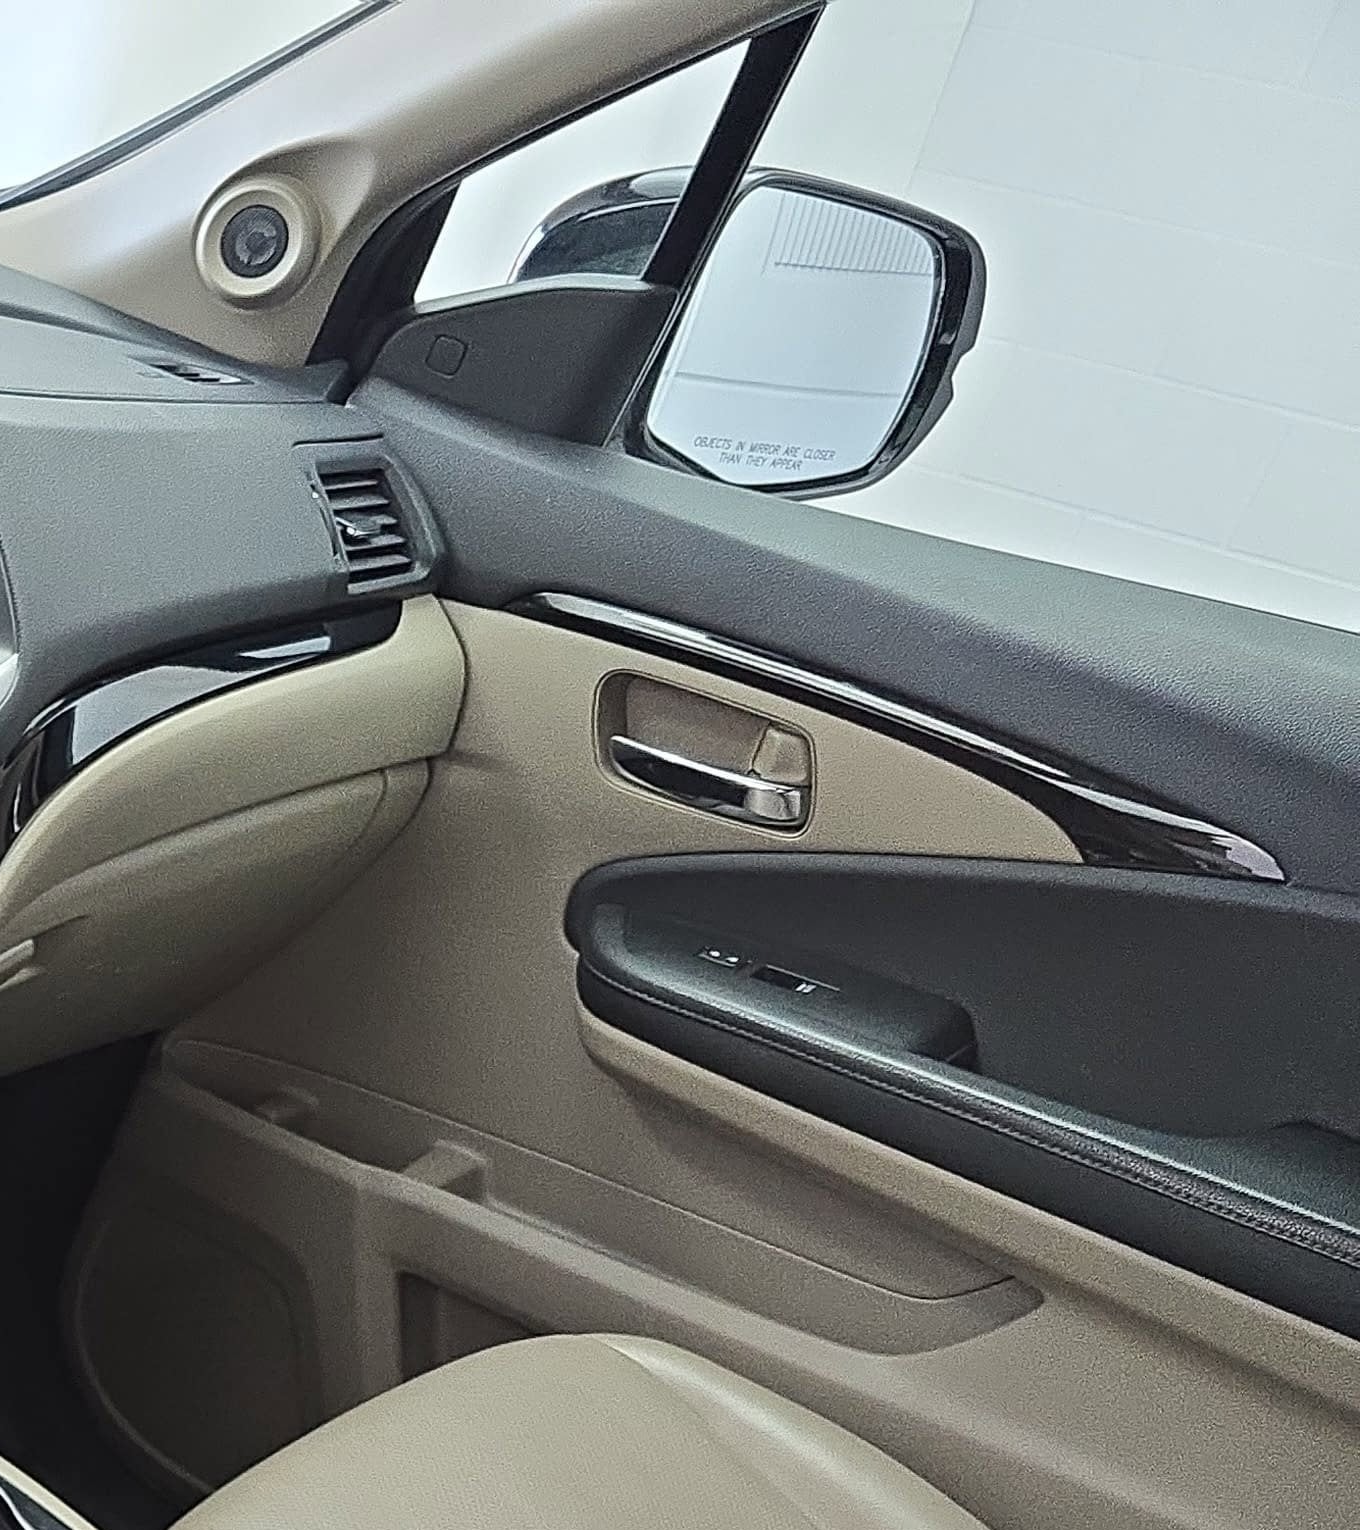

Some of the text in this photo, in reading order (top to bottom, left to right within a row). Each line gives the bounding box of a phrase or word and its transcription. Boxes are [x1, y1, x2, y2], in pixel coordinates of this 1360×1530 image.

[693, 436, 836, 461] OBJECTS IN MIRROR ARE CLOSER
[719, 452, 803, 471] THAN THEY APPEAR
